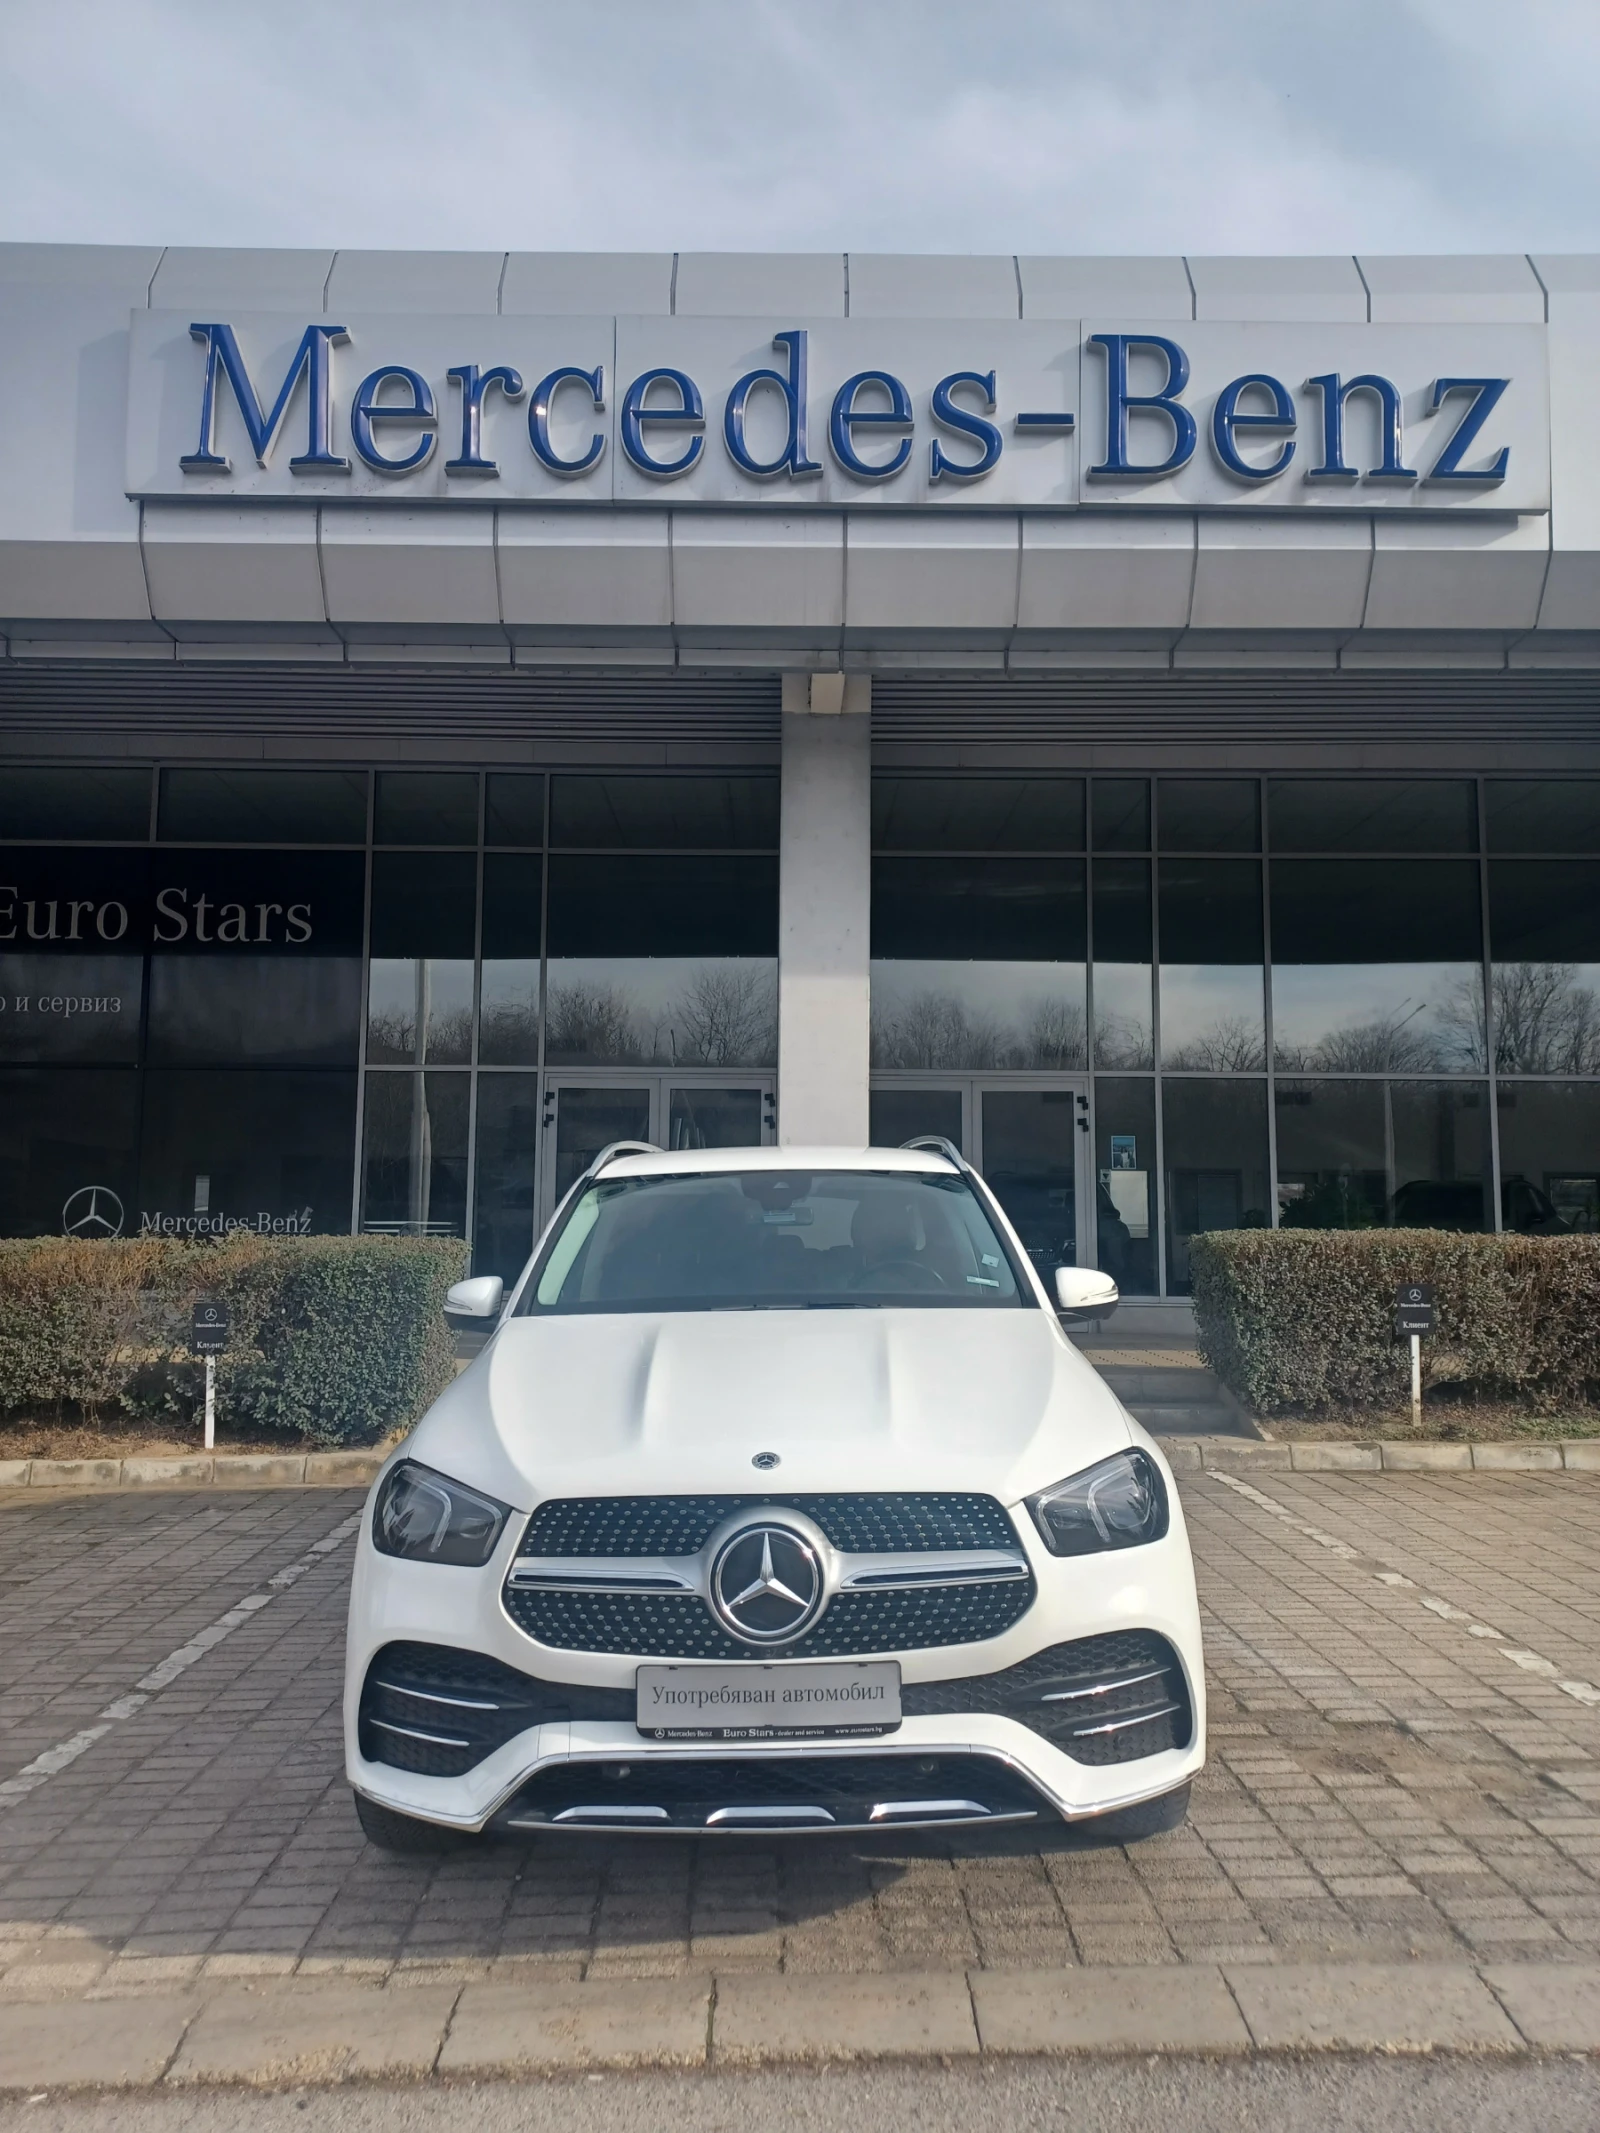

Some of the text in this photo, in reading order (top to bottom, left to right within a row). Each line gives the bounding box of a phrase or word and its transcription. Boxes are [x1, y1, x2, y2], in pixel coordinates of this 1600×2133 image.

[181, 322, 1512, 485] Mercedes-Benz
[153, 887, 313, 943] Stars
[15, 996, 30, 1012] и
[38, 996, 121, 1018] сервиз
[141, 1211, 312, 1233] Mercedes-Benz
[652, 1682, 885, 1708] Употребяван автомобил
[723, 1728, 747, 1738] Euro
[748, 1728, 774, 1738] Stars
